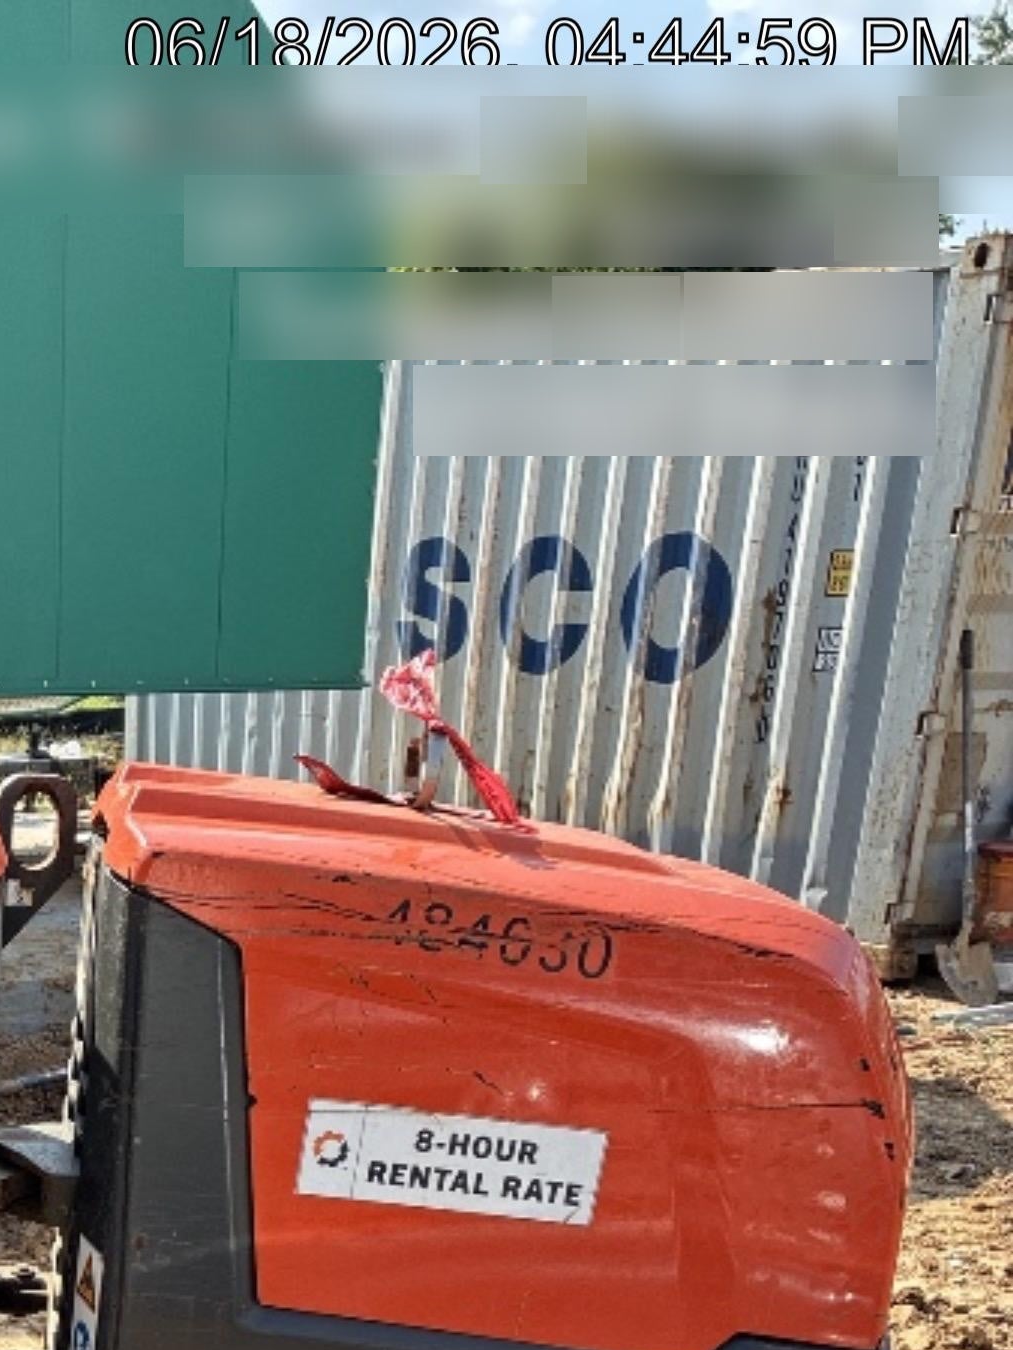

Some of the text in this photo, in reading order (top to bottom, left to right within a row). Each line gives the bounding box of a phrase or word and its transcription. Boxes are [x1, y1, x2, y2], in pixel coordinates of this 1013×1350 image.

[414, 1128, 538, 1164] 8-HOUR
[367, 1160, 583, 1207] RENTAL RATE
